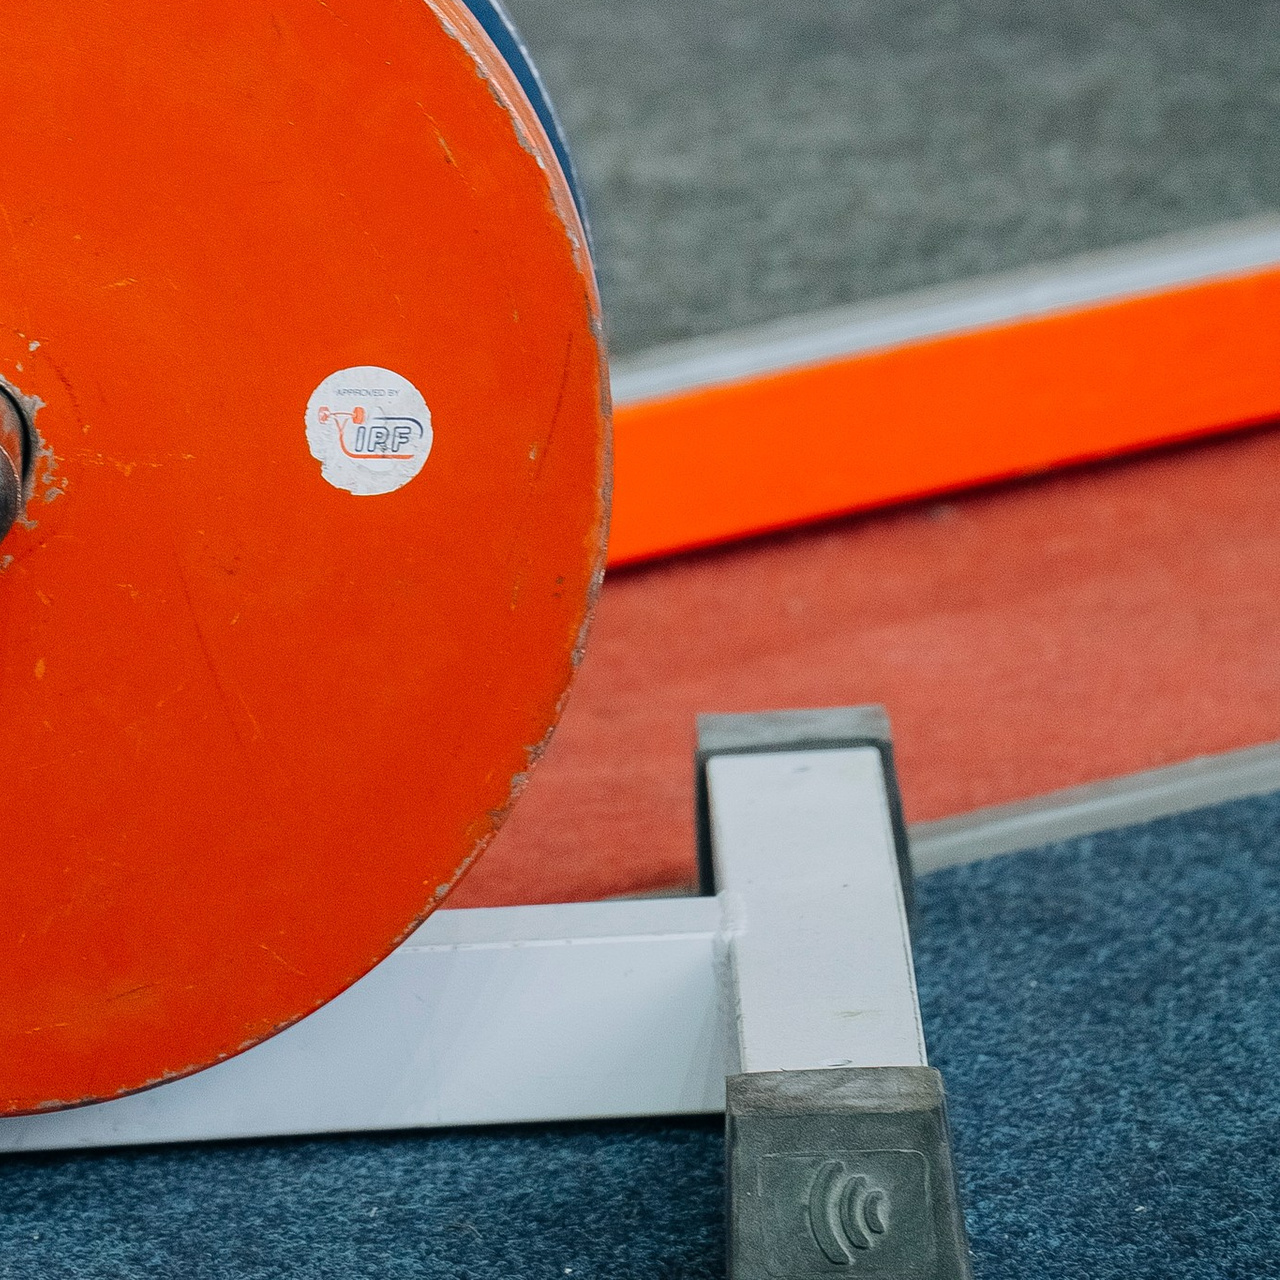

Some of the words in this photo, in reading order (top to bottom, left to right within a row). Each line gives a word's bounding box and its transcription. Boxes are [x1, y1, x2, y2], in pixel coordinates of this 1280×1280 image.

[336, 389, 386, 397] APPROVED
[388, 389, 400, 397] BY
[355, 426, 411, 452] IPF
